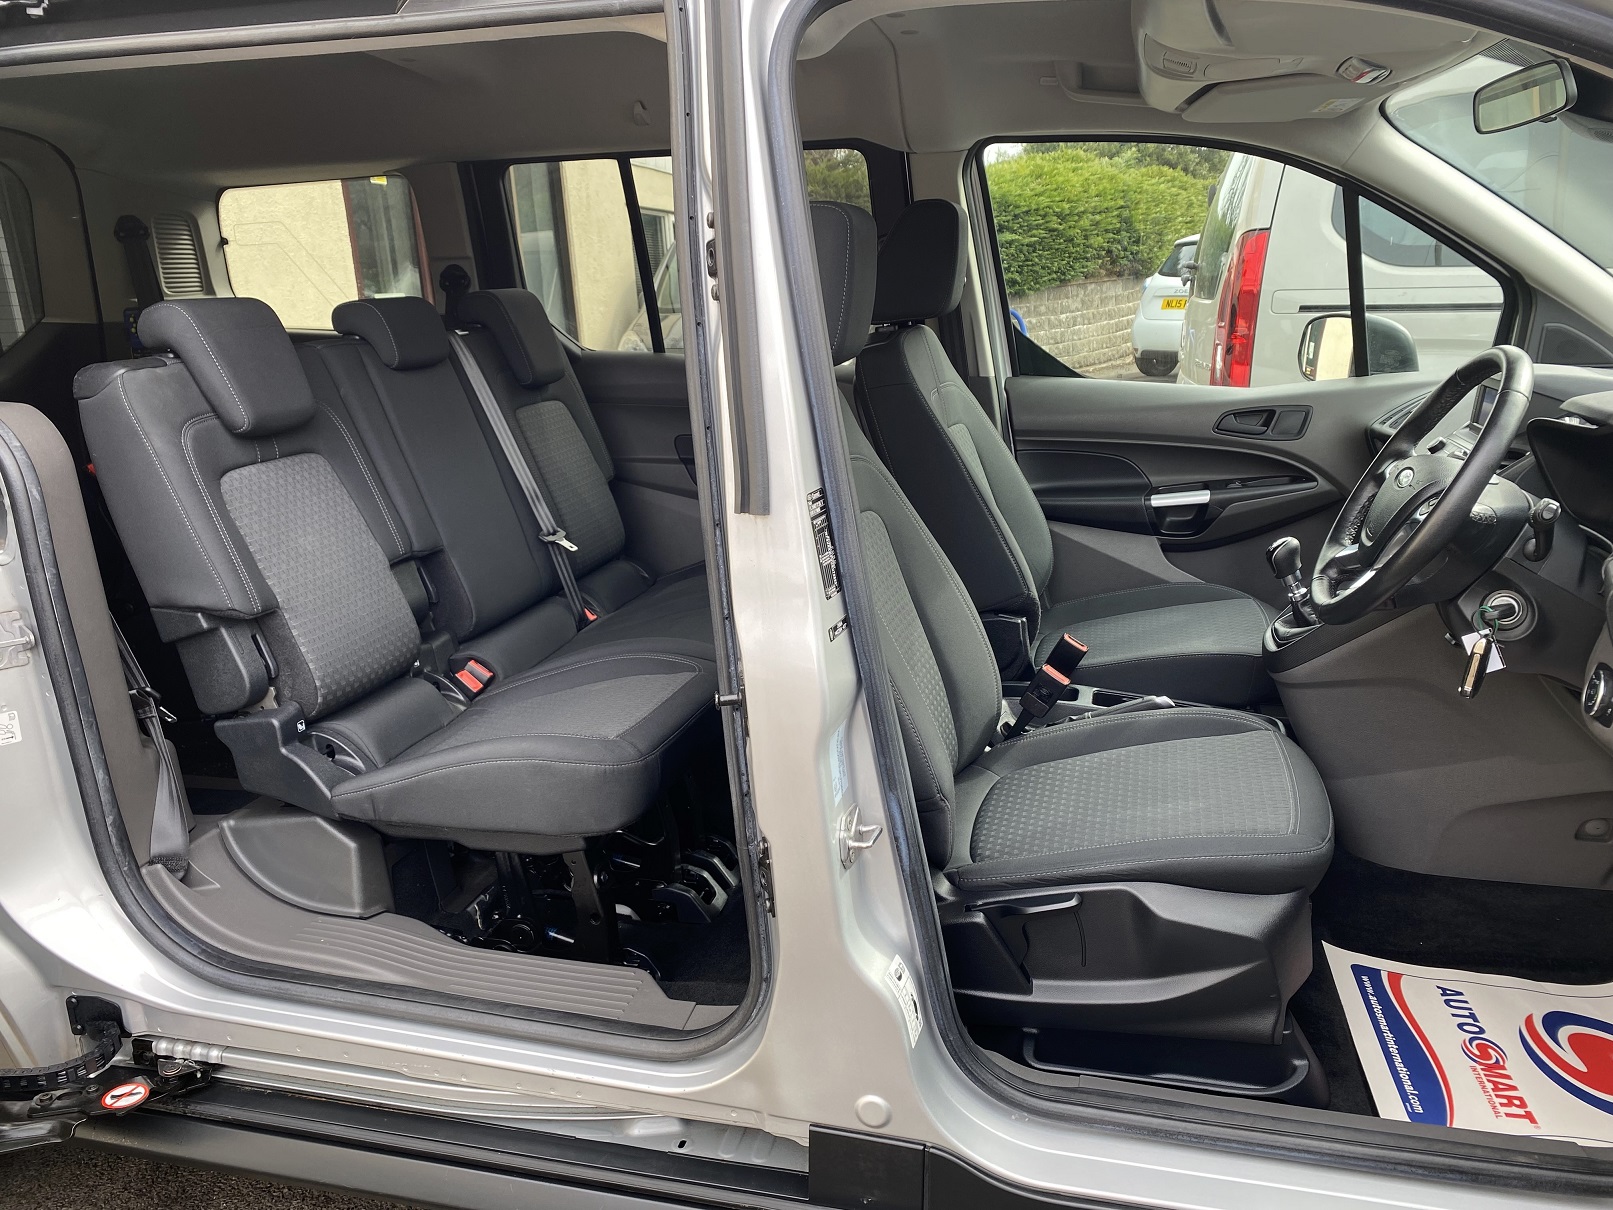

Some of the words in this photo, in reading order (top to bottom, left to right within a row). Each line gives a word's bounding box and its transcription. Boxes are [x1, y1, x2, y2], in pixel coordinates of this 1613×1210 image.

[1165, 299, 1183, 308] NL15
[1361, 975, 1424, 1114] www.autosmartinternational.com
[1469, 1065, 1503, 1119] INTERNATIONAL
